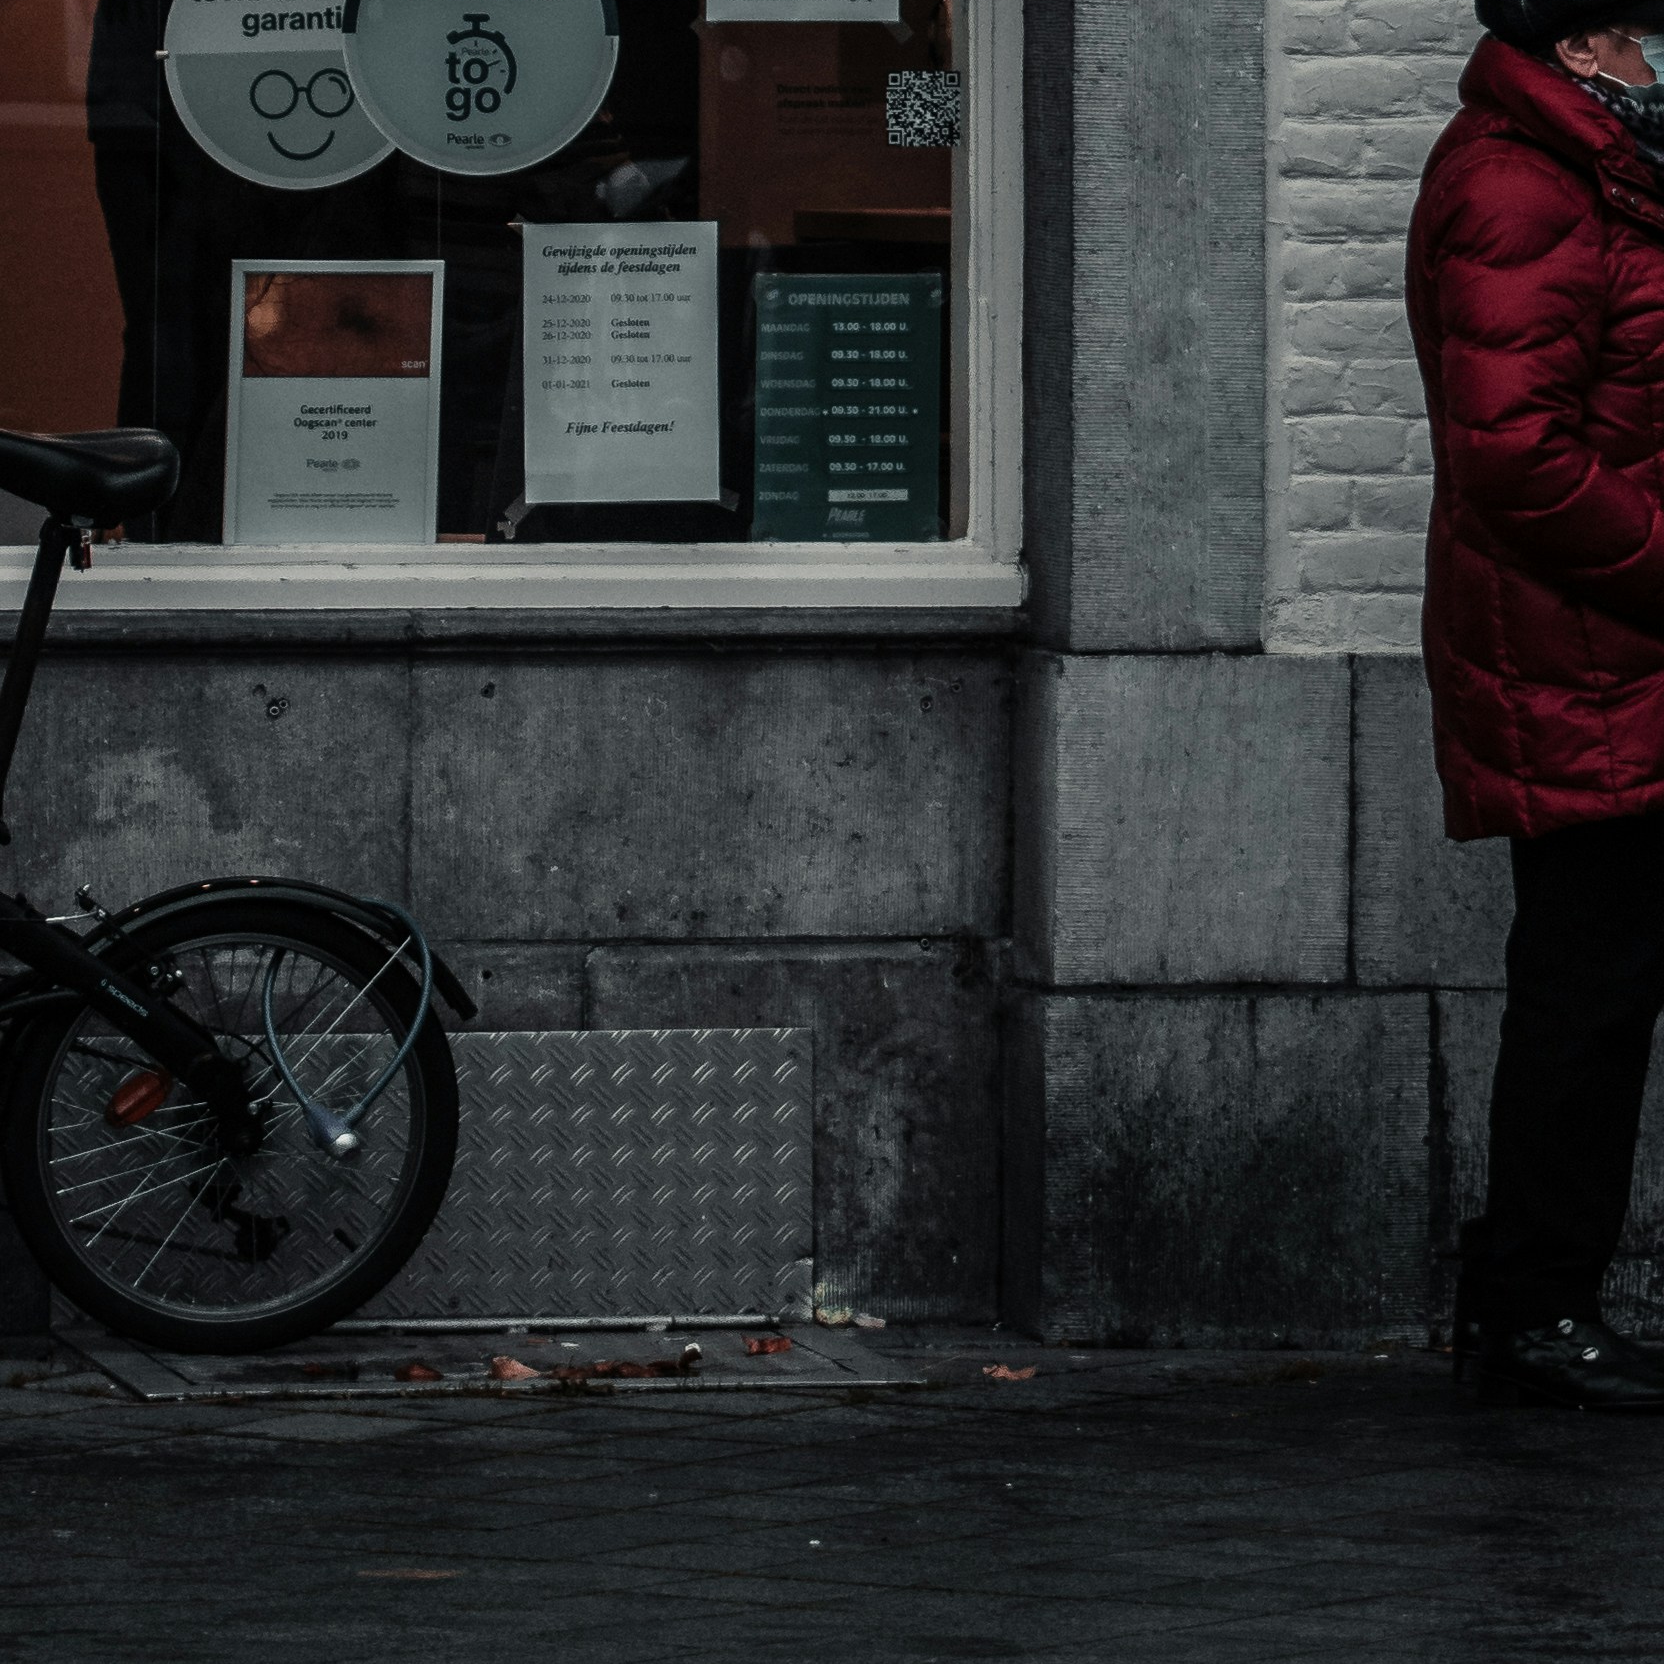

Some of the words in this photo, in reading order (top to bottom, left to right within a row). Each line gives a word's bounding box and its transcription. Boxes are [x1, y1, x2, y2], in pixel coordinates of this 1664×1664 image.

[242, 6, 342, 37] garanti
[445, 52, 489, 84] to
[445, 87, 501, 121] go
[446, 133, 485, 146] Pearle
[543, 245, 606, 260] Gewijzigde
[609, 243, 697, 259] openingstijden
[558, 262, 597, 276] tijdens
[600, 262, 614, 273] de
[616, 261, 681, 275] feestdagen
[542, 294, 592, 304] 24-12-2020
[610, 293, 635, 302] 09.30
[636, 294, 648, 302] tot
[651, 293, 674, 302] 17.00
[788, 292, 910, 306] OPENINGSTIJDEN
[542, 319, 592, 328] 25-12-2020
[610, 318, 650, 327] Gesloten
[869, 322, 896, 331] 18.00
[542, 331, 592, 341] 26-12-2020
[610, 330, 650, 339] Gesloten
[542, 355, 592, 365] 31-12-2020
[610, 354, 635, 363] 09.30
[637, 355, 648, 363] tot
[651, 354, 675, 363] 17.00
[831, 350, 859, 359] 09.30
[868, 350, 896, 359] 18.00
[542, 380, 590, 389] 01-01-2021
[611, 379, 650, 388] Gesloten
[868, 378, 896, 387] 18.00
[300, 404, 371, 415] Gecertificeerd
[831, 406, 859, 415] 09.30
[344, 419, 376, 427] center
[565, 422, 598, 436] Fijne
[601, 421, 675, 436] Feestdagen!
[321, 430, 348, 440] 2019
[870, 434, 896, 443] 18.00
[306, 458, 338, 469] Pearle
[828, 462, 857, 471] 09.30
[866, 462, 894, 471] 17.00
[107, 984, 149, 1018] speeds
